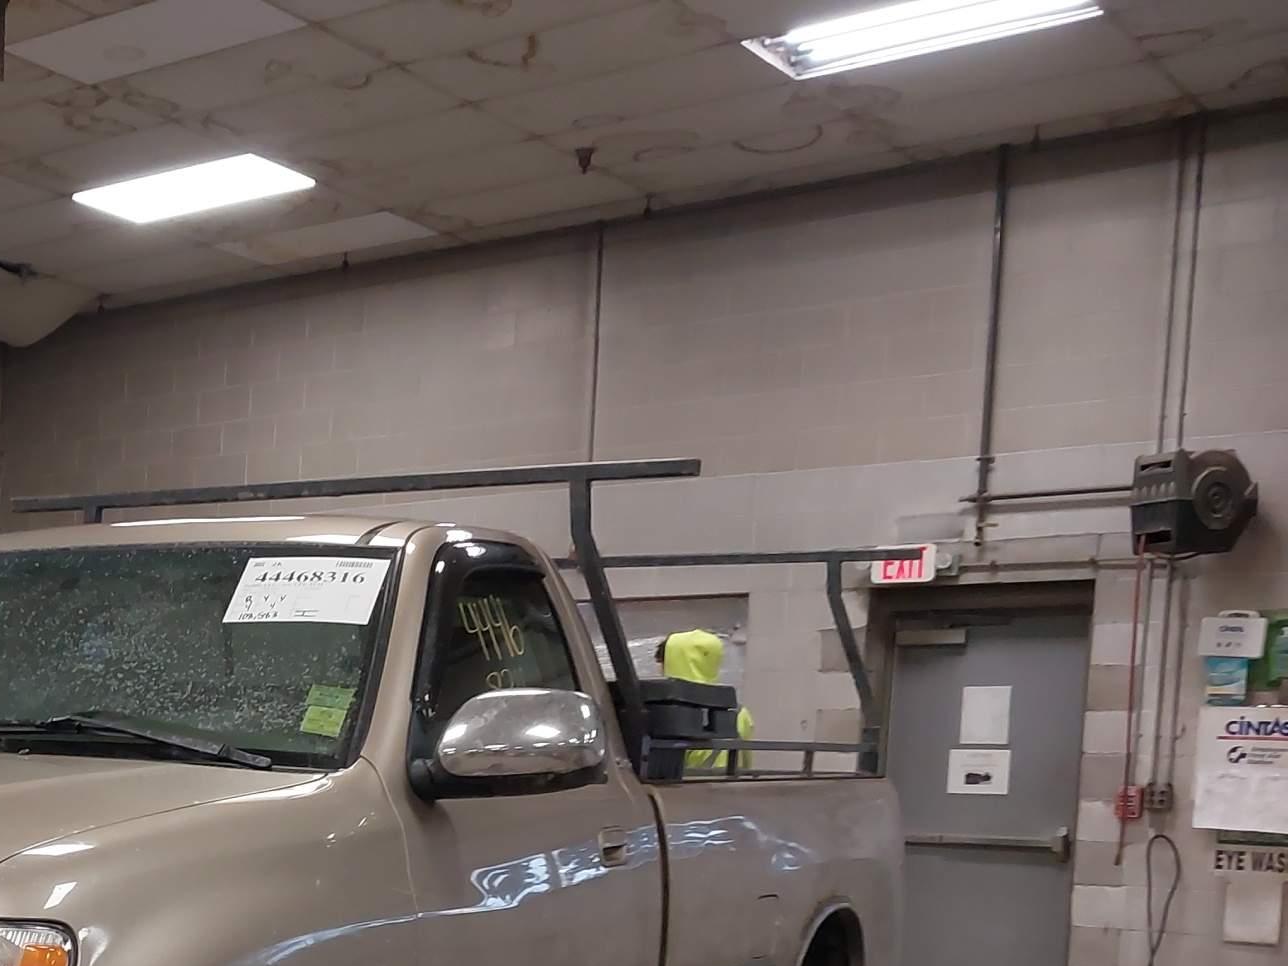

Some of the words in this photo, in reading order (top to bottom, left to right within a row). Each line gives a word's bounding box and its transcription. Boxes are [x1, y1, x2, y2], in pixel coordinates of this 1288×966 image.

[881, 546, 928, 580] EXIT
[255, 569, 367, 584] 44468316
[1214, 849, 1247, 870] EYE
[1251, 851, 1288, 873] WAS
